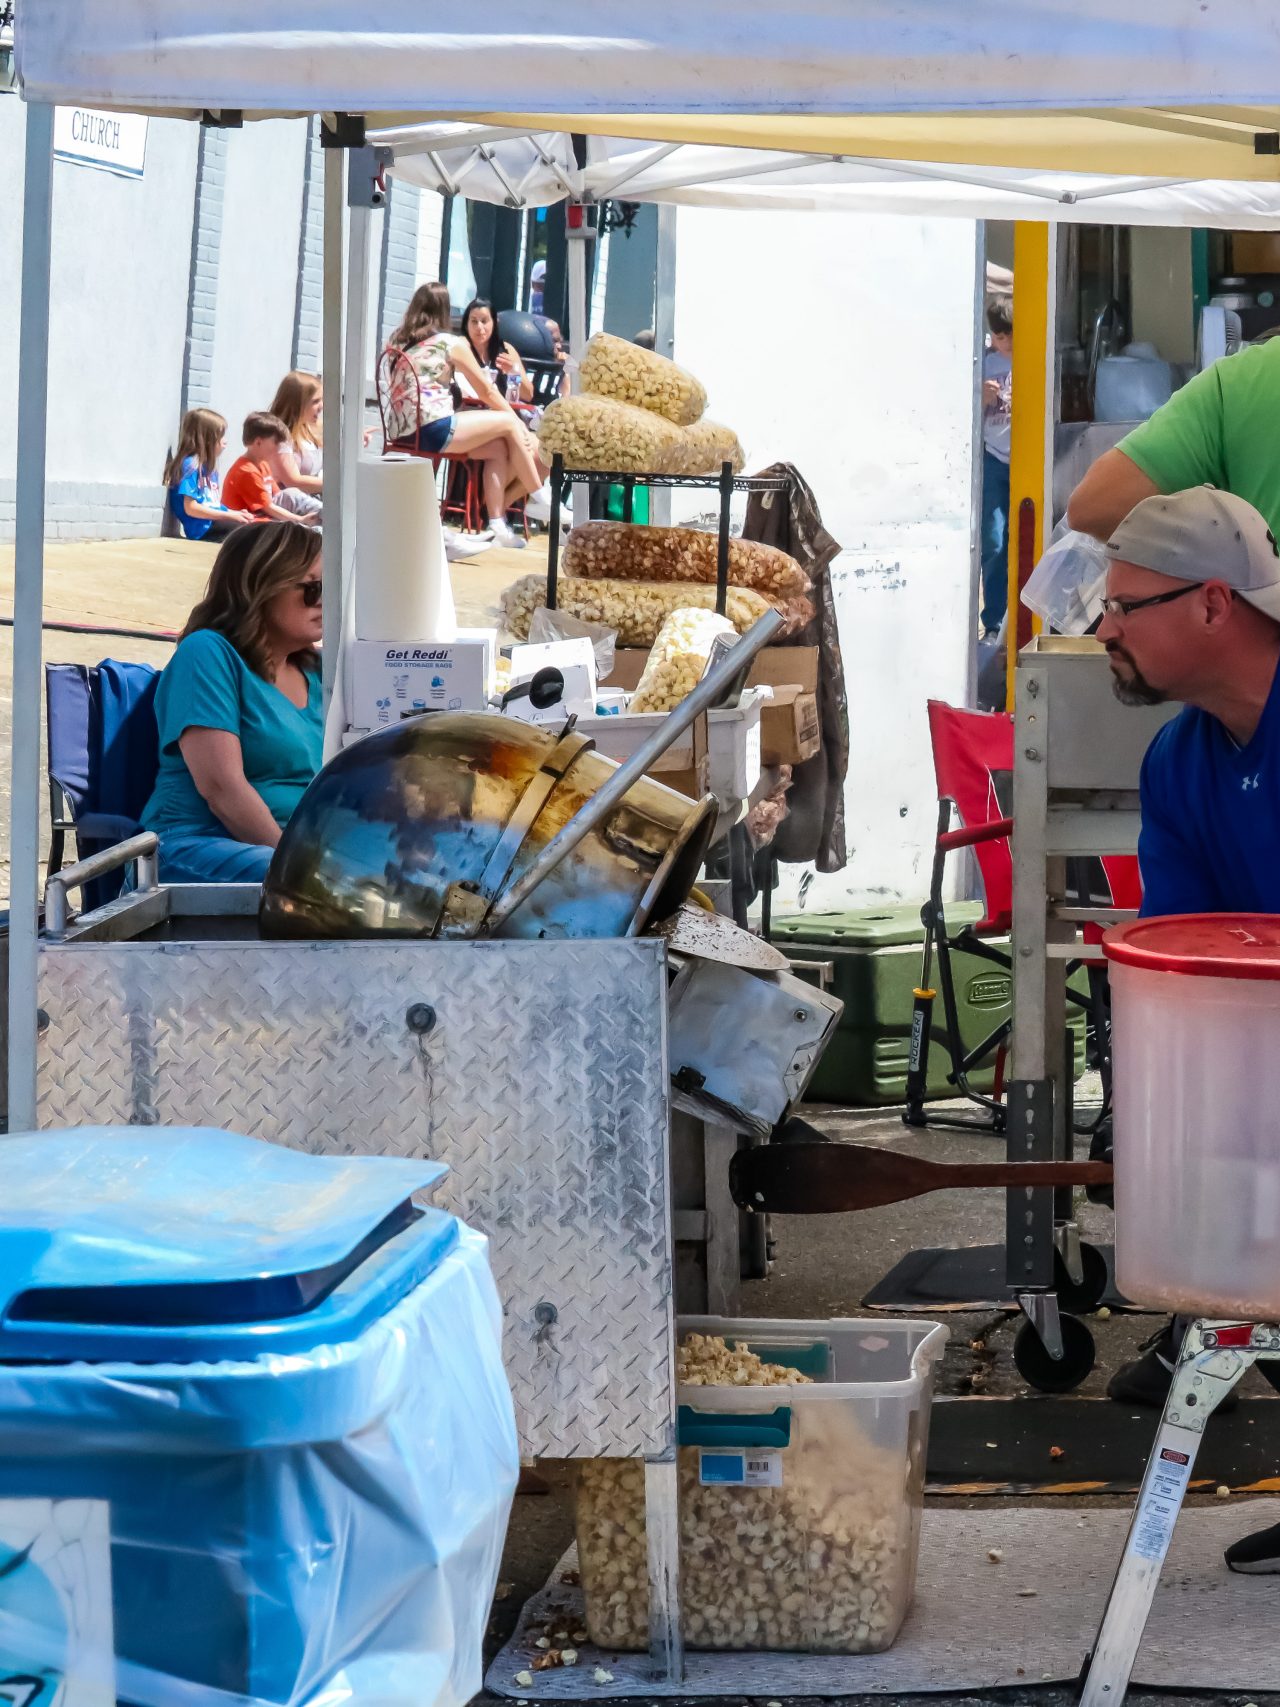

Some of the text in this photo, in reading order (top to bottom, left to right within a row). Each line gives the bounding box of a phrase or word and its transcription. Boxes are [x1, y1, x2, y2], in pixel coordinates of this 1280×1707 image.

[72, 110, 120, 149] CHURCH
[386, 650, 448, 659] Get Reddi
[911, 1018, 920, 1064] ROCKER
